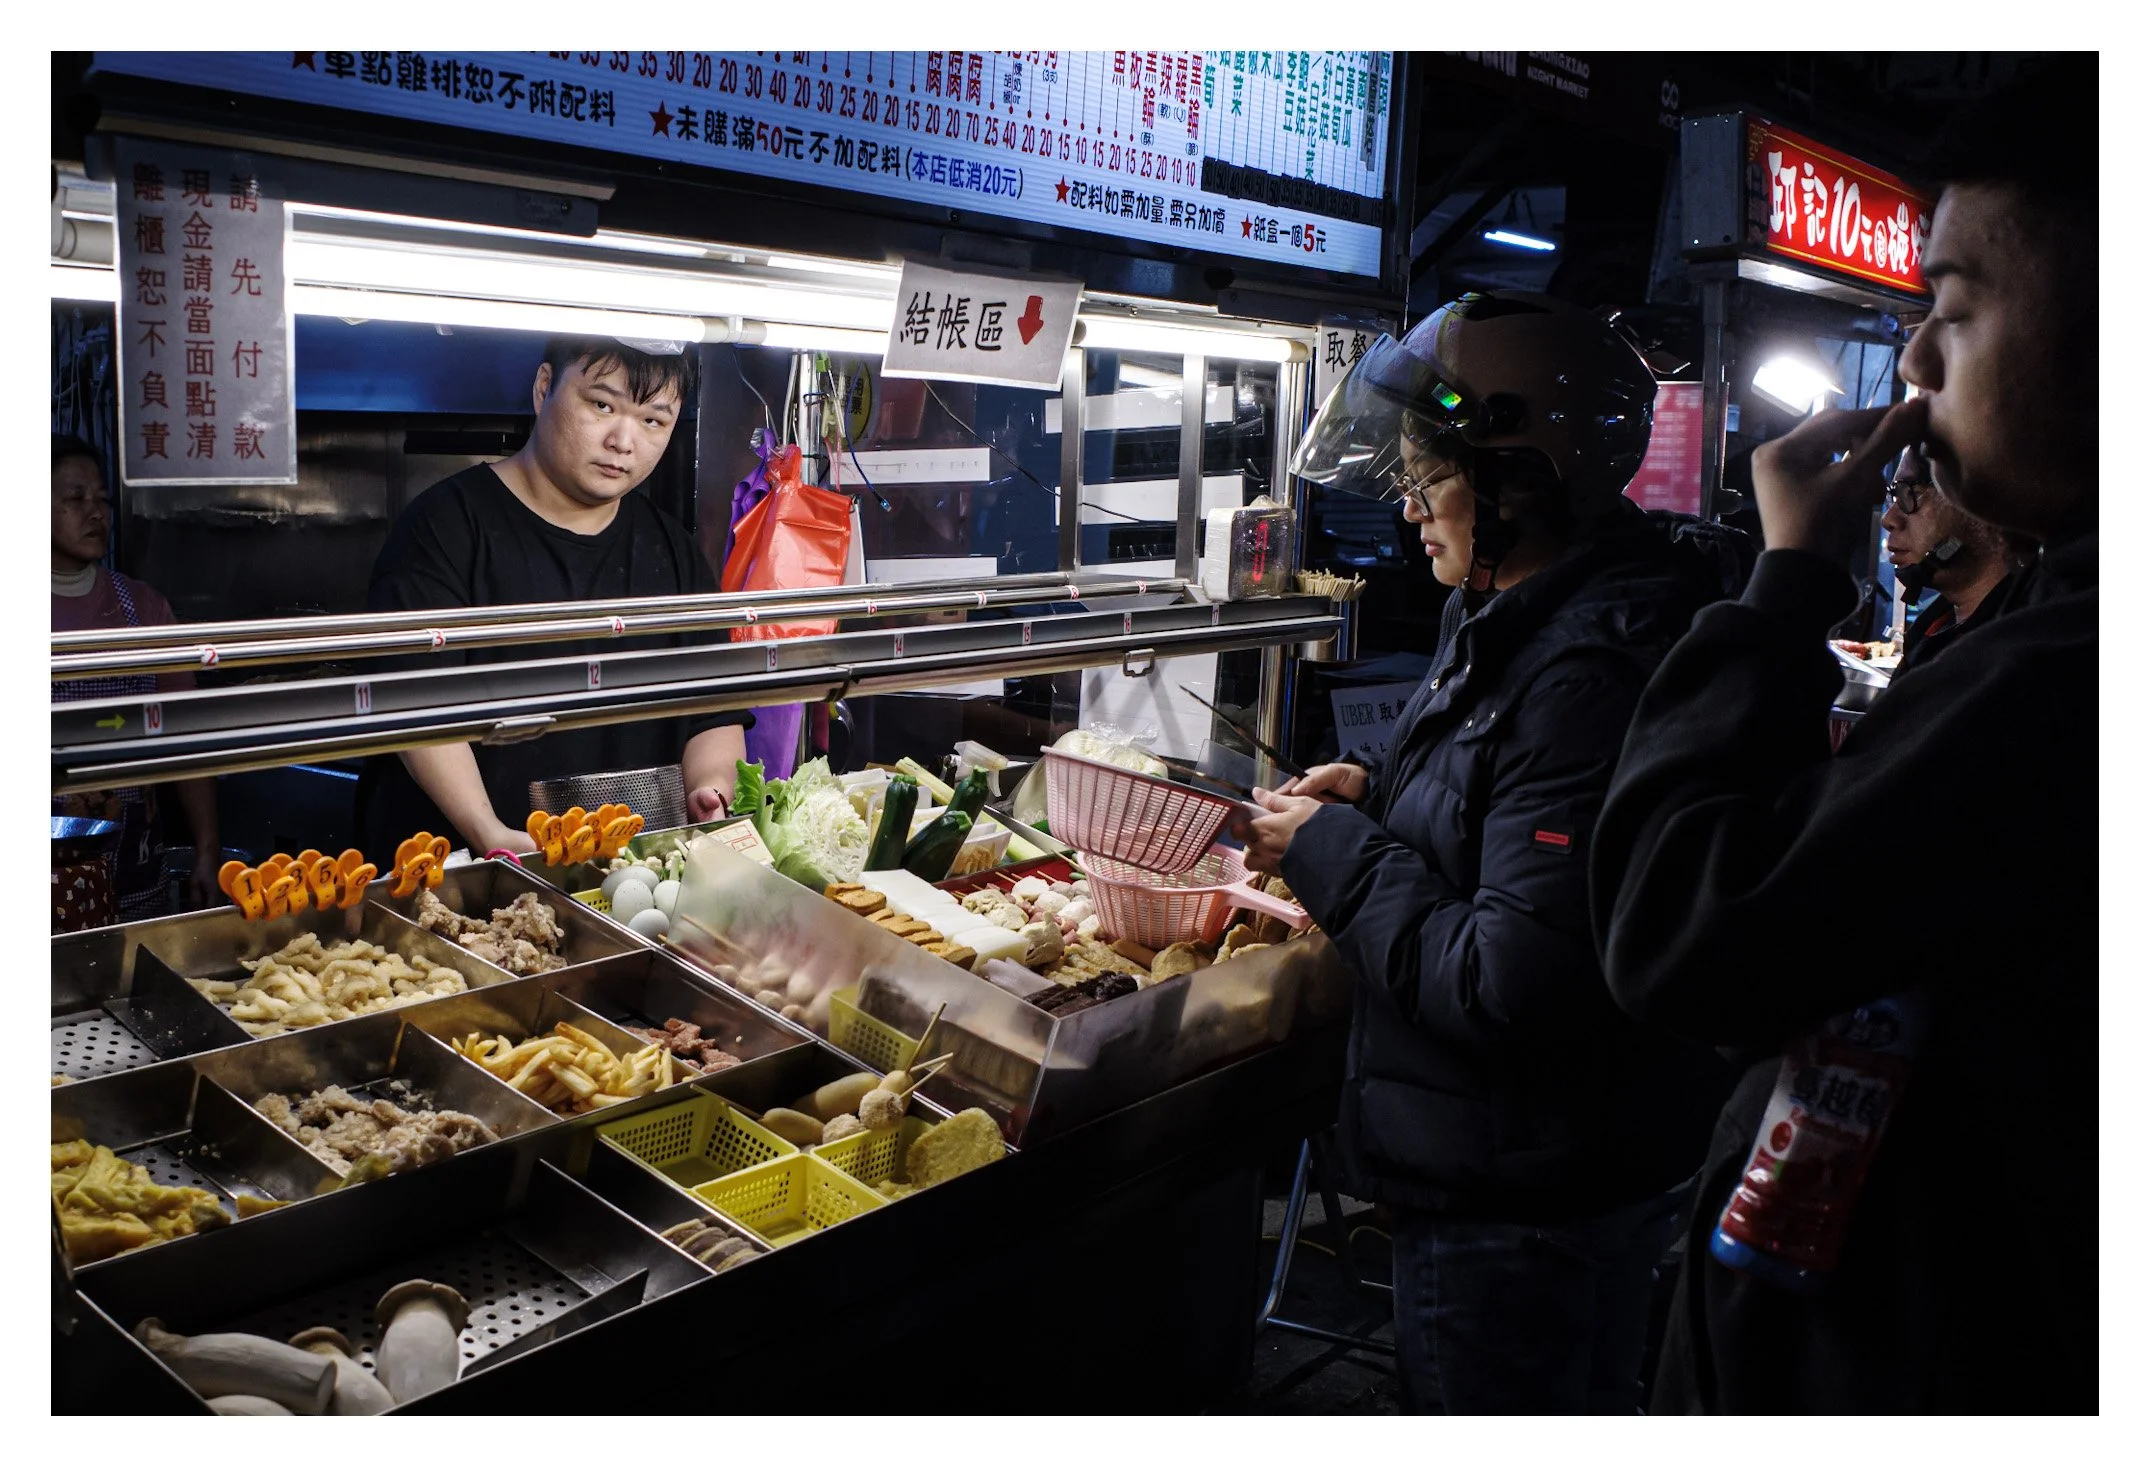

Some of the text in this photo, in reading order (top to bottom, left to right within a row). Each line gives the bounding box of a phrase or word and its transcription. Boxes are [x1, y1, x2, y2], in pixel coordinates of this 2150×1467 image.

[966, 53, 983, 107] 腐
[1527, 65, 1590, 100] NIGHT MARKET
[1319, 51, 1333, 142] 針菇
[1332, 51, 1346, 146] 白筍
[638, 51, 658, 78] 35
[667, 51, 685, 84] 30
[693, 52, 711, 89] 20
[720, 58, 737, 94] 20
[745, 63, 762, 99] 30
[770, 70, 786, 104] 40
[794, 74, 810, 109] 20
[817, 80, 833, 113] 30
[840, 84, 856, 118] 25
[862, 89, 878, 123] 20
[884, 93, 899, 127] 20
[905, 98, 920, 132] 15
[925, 103, 940, 136] 20
[945, 106, 960, 139] 20
[966, 110, 980, 142] 70
[985, 113, 999, 146] 25
[1003, 120, 1017, 150] 40
[1022, 123, 1036, 153] 20
[1040, 127, 1053, 157] 20
[1059, 131, 1070, 161] 15
[1076, 135, 1088, 164] 10
[1093, 139, 1105, 168] 15
[1109, 143, 1121, 171] 20
[1125, 147, 1137, 175] 15
[1141, 150, 1153, 178] 25
[1156, 154, 1168, 181] 20
[1172, 157, 1182, 184] 10
[1186, 160, 1196, 187] 10
[1070, 180, 1226, 235] 配料如需加量,需另加價
[1253, 214, 1328, 254] 紙盒一個5元
[132, 162, 169, 461] 離櫃恕不負責
[181, 168, 217, 460] 現金請當面點清
[228, 174, 265, 460] 請先付款
[899, 290, 1008, 352] 結帳區
[1325, 329, 1379, 373] 取餐
[434, 631, 446, 647] 3
[612, 619, 625, 635] 4
[1023, 624, 1031, 643] 15
[204, 648, 217, 667] 2
[768, 648, 777, 668] 13
[894, 636, 903, 655] 14
[590, 664, 600, 686] 12
[357, 682, 370, 709] 11
[145, 703, 160, 730] 10
[1340, 702, 1376, 728] UBER
[546, 821, 563, 841] 13
[319, 863, 331, 886] 5
[354, 872, 369, 887] 6
[411, 860, 430, 876] 8
[273, 884, 288, 901] 2
